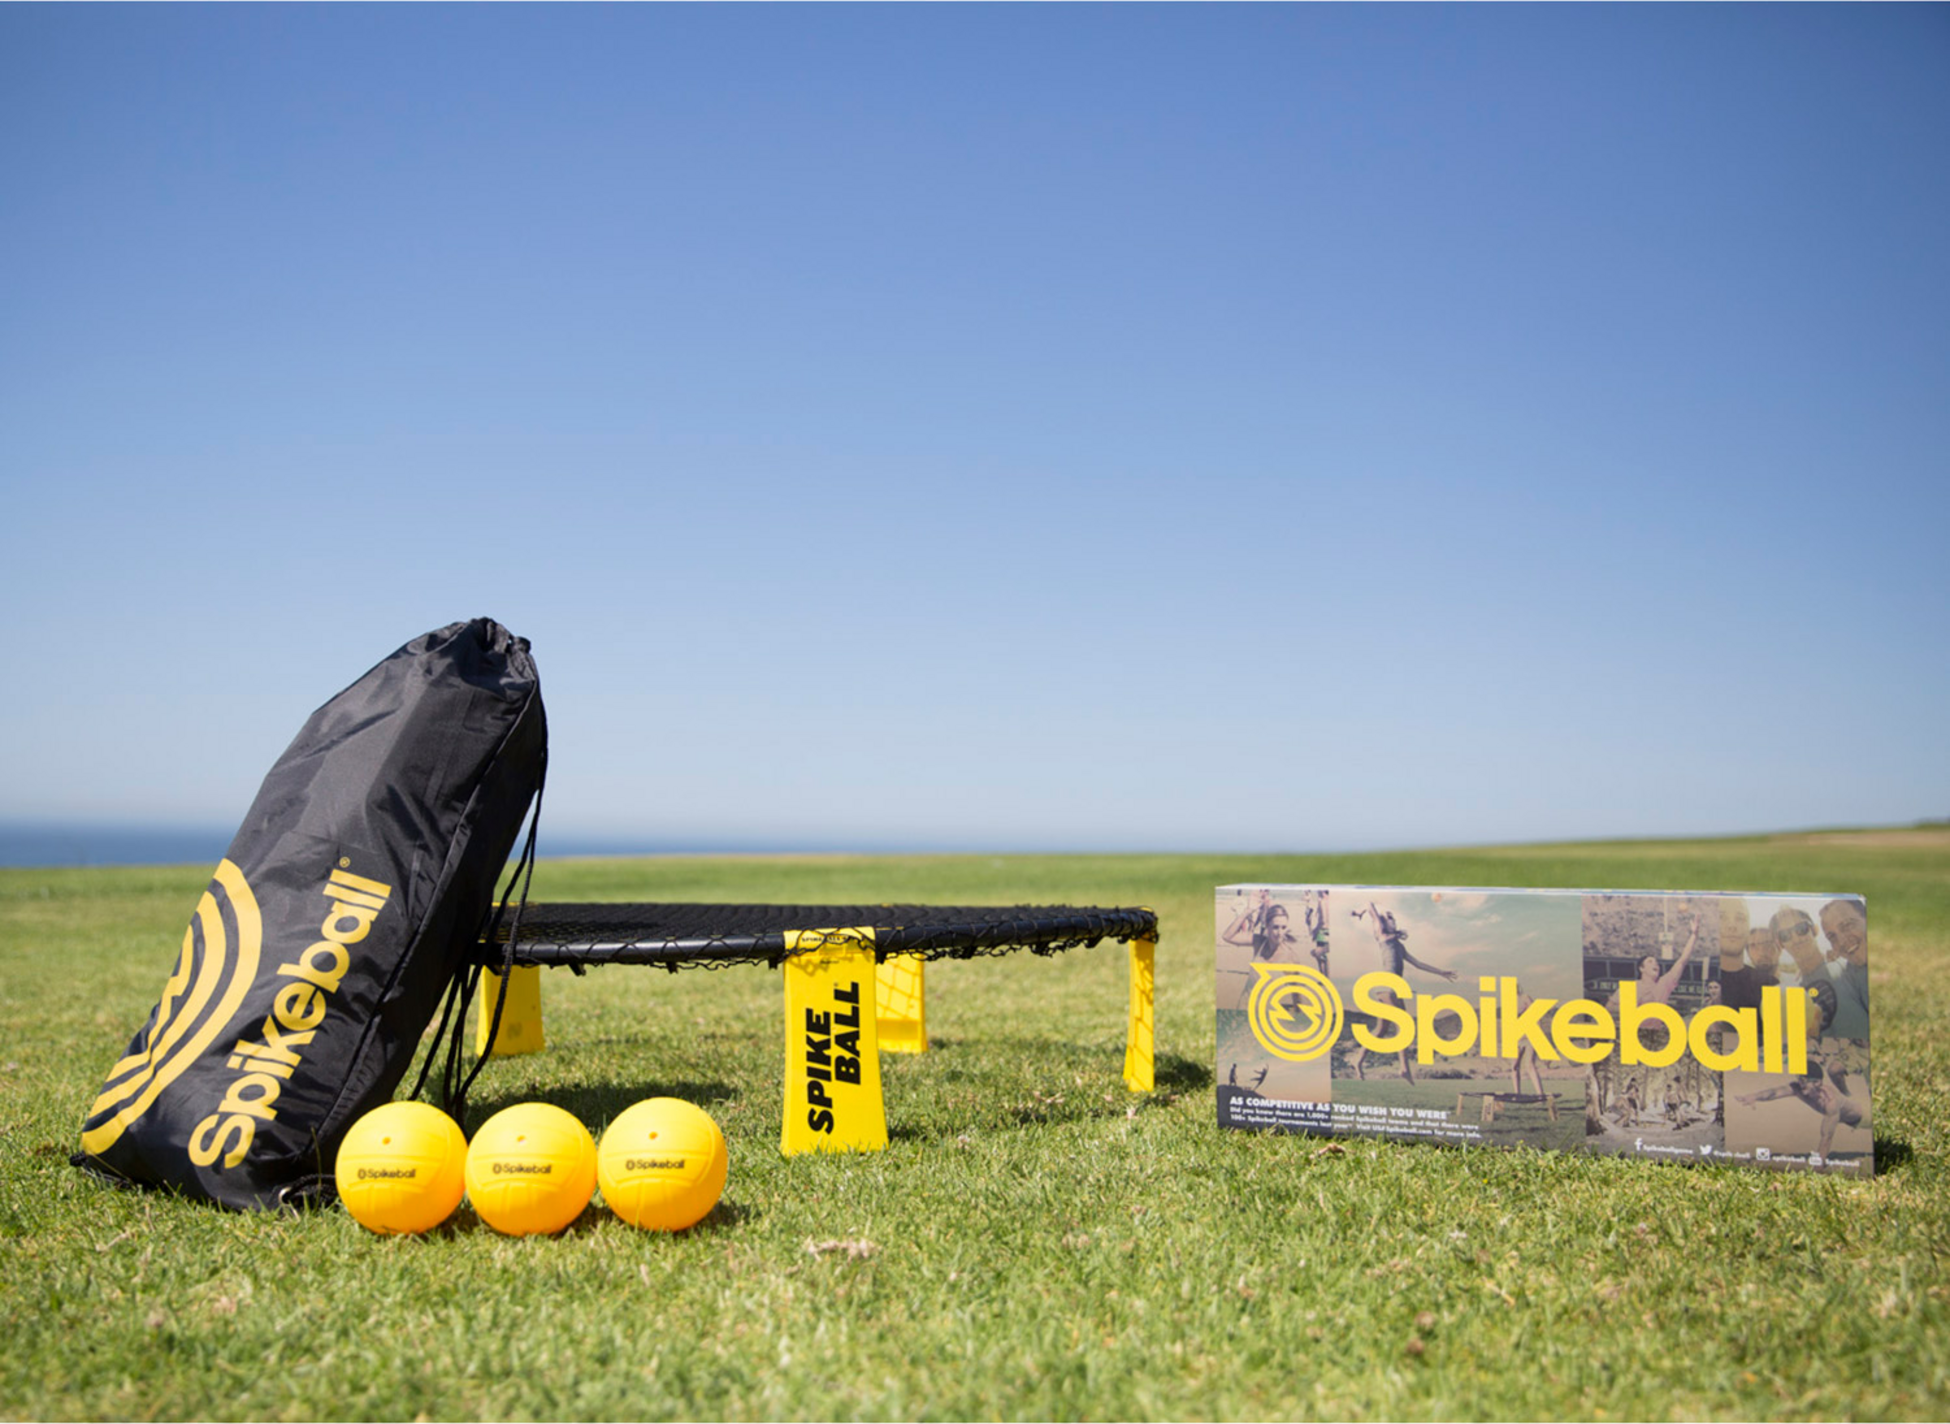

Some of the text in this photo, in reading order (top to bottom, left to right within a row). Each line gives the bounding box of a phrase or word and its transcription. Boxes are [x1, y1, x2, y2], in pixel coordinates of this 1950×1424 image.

[188, 868, 392, 1169] Spikeball
[834, 981, 861, 1085] BALL
[1351, 971, 1808, 1075] Spikeball
[806, 1008, 834, 1135] SPIKE
[1229, 1096, 1244, 1105] AS
[1246, 1097, 1314, 1110] COMPETITIVE
[1316, 1103, 1330, 1112] AS
[1332, 1103, 1356, 1113] YOU
[1358, 1105, 1387, 1116] WISH
[1389, 1106, 1414, 1117] YOU
[367, 1168, 417, 1180] Spikeball
[503, 1163, 552, 1174] Spikeball
[636, 1158, 685, 1170] Spikeball
